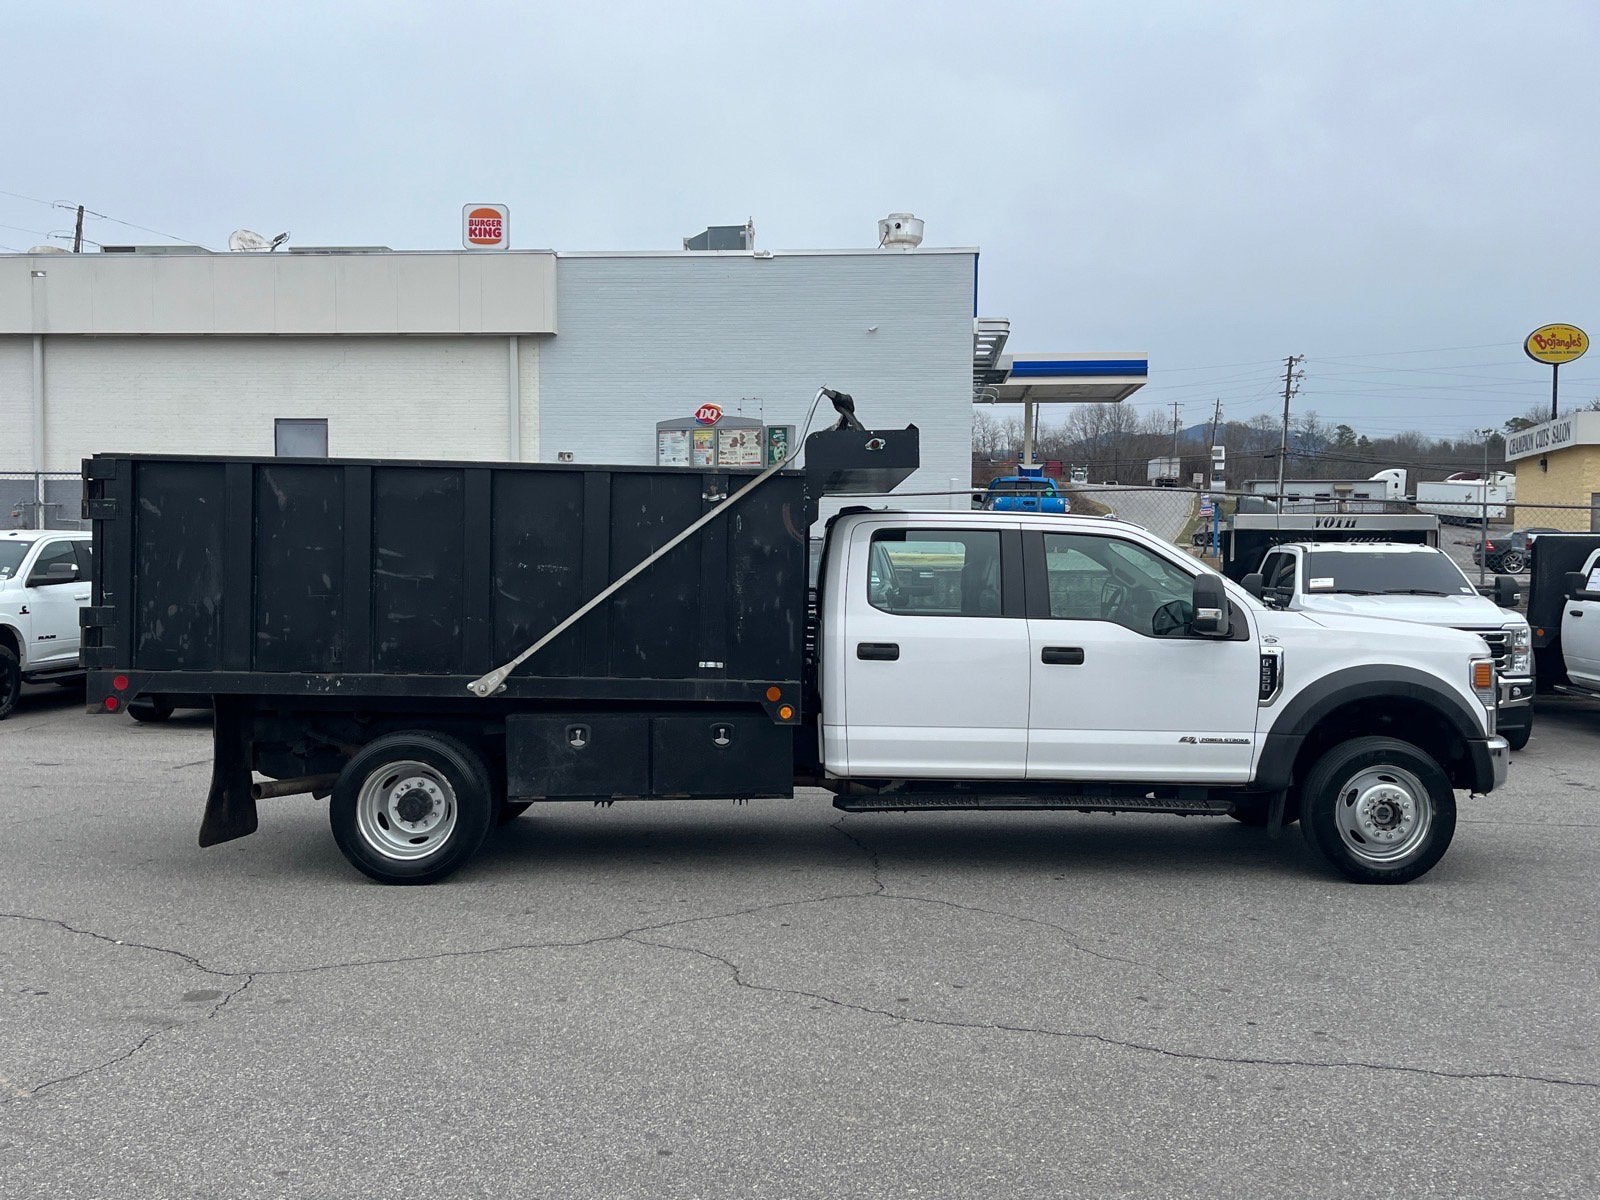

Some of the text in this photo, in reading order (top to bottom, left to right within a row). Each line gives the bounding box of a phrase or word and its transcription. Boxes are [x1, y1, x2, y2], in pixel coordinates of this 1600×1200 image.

[468, 219, 502, 227] BURGER
[468, 227, 502, 238] KING
[700, 408, 718, 421] DQ
